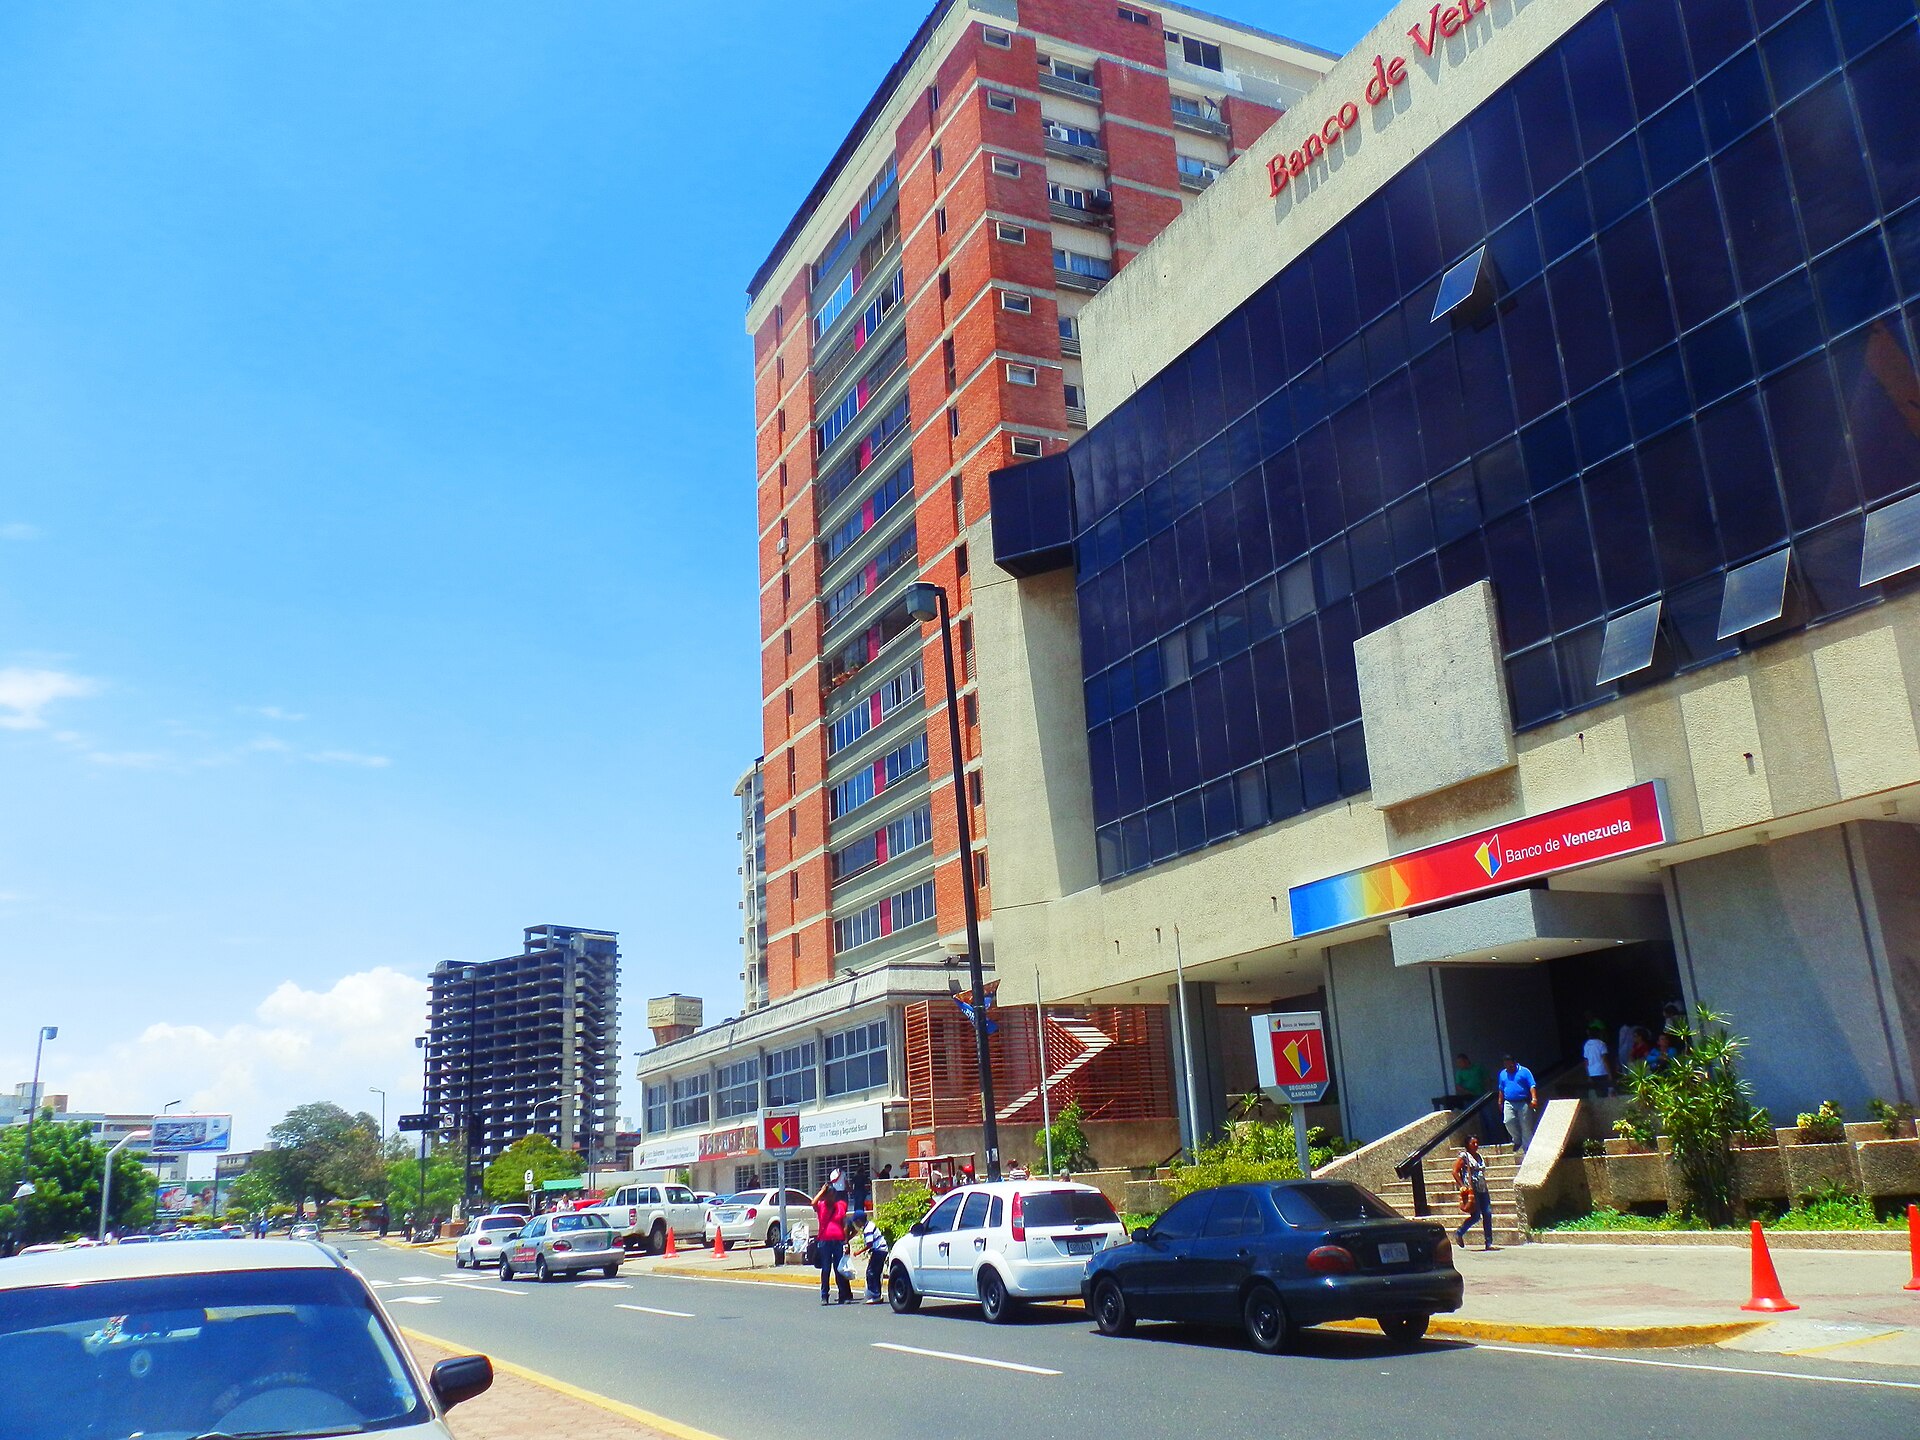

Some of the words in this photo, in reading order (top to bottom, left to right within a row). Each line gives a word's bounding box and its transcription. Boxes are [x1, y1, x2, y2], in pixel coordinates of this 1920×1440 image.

[1265, 101, 1359, 198] Banco
[1365, 54, 1408, 105] de
[1505, 843, 1542, 863] Banco
[1545, 838, 1561, 853] de
[1562, 819, 1632, 847] Venezuela
